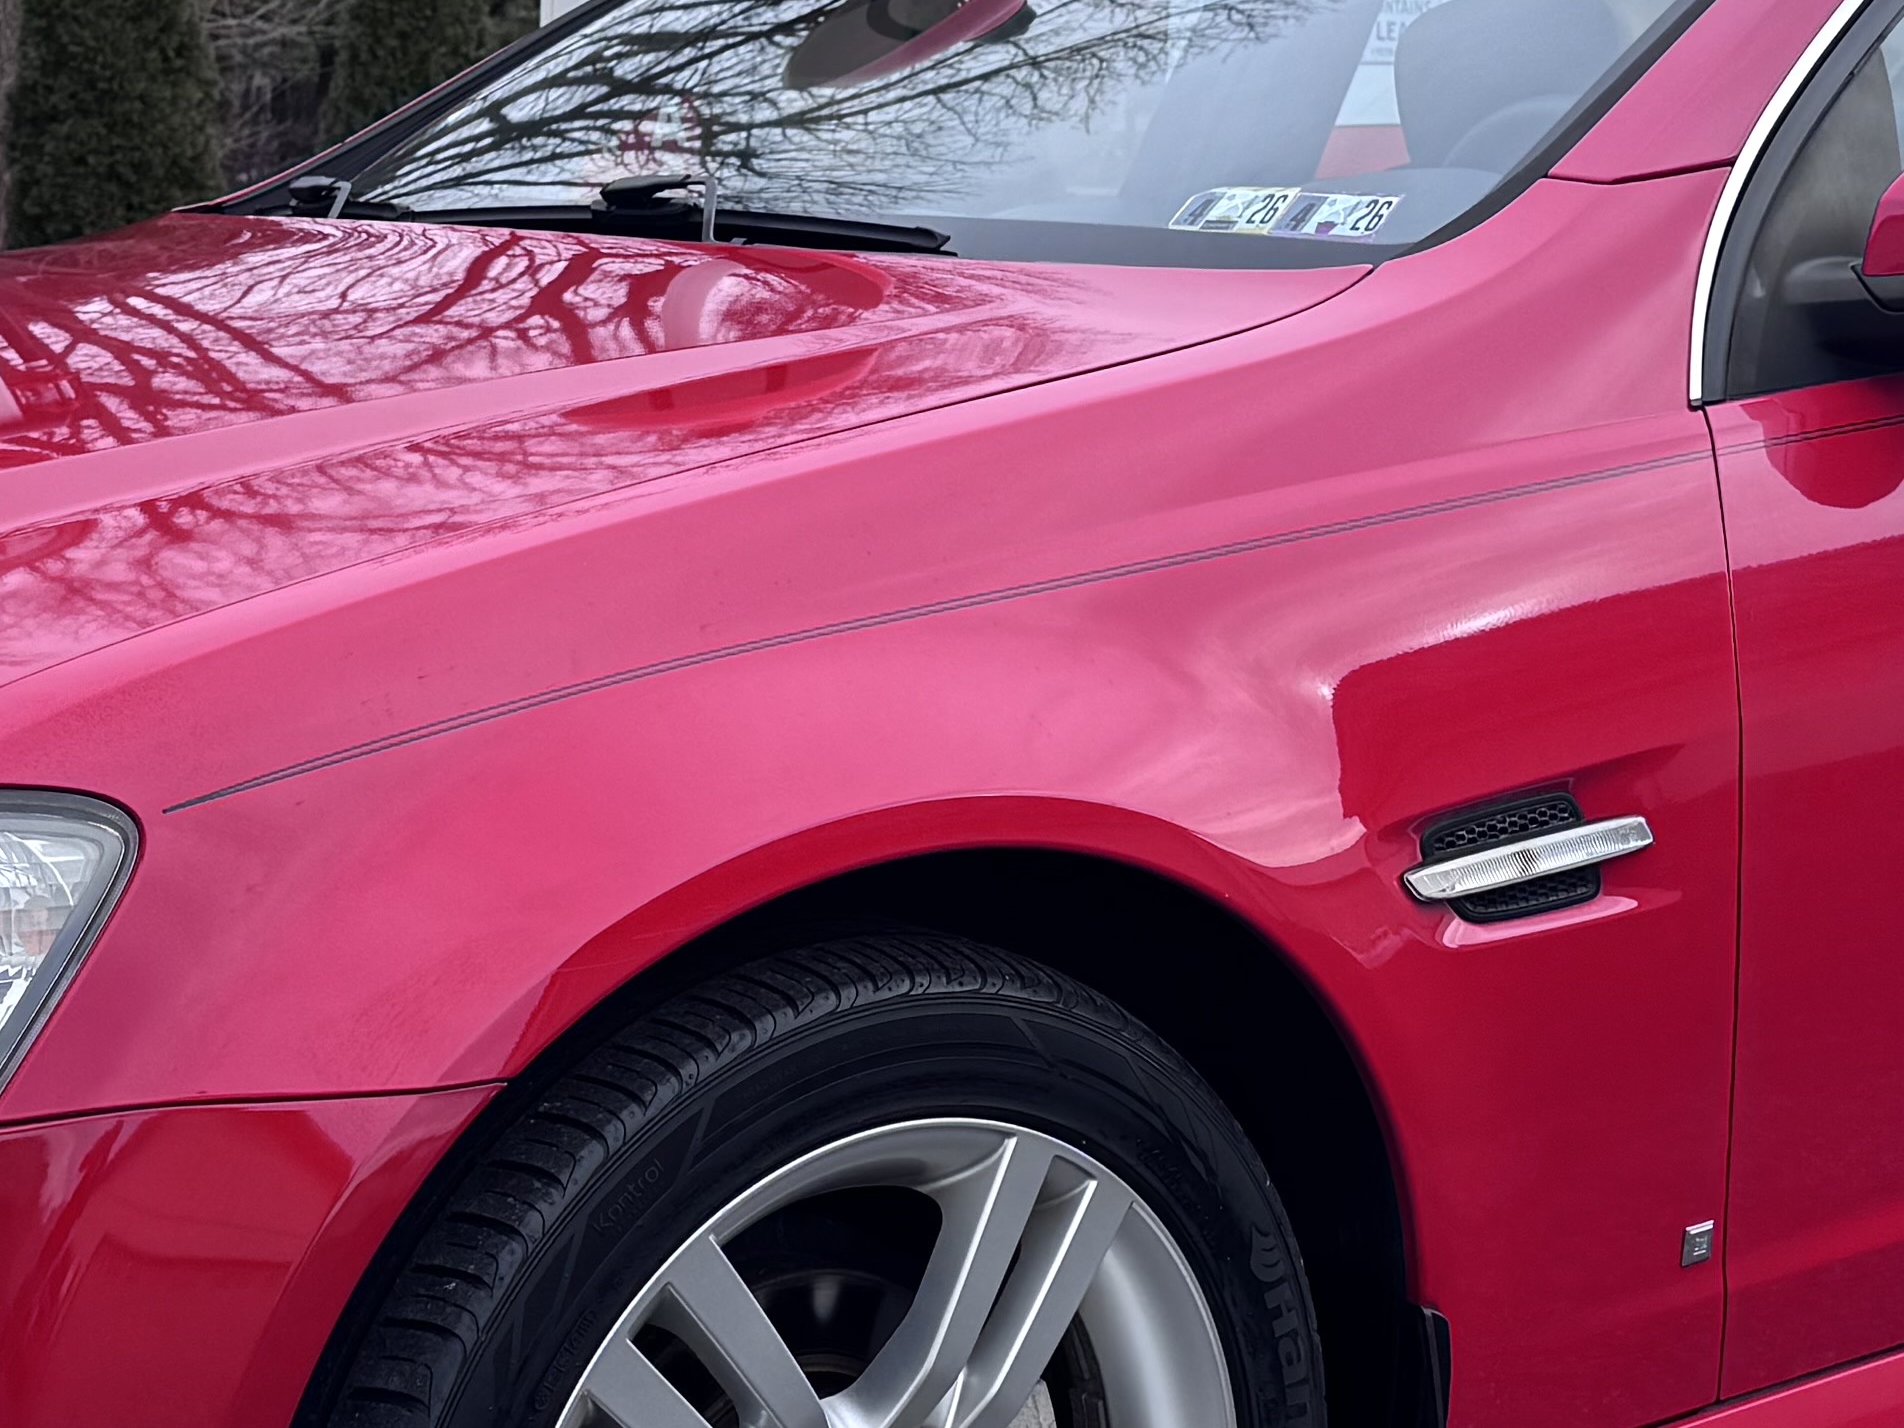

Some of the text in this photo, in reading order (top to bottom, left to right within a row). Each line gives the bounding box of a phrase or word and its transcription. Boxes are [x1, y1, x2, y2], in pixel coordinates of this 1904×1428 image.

[1187, 193, 1289, 226] 4 26
[1289, 199, 1394, 232] 4 26
[593, 1158, 664, 1234] Kontrol
